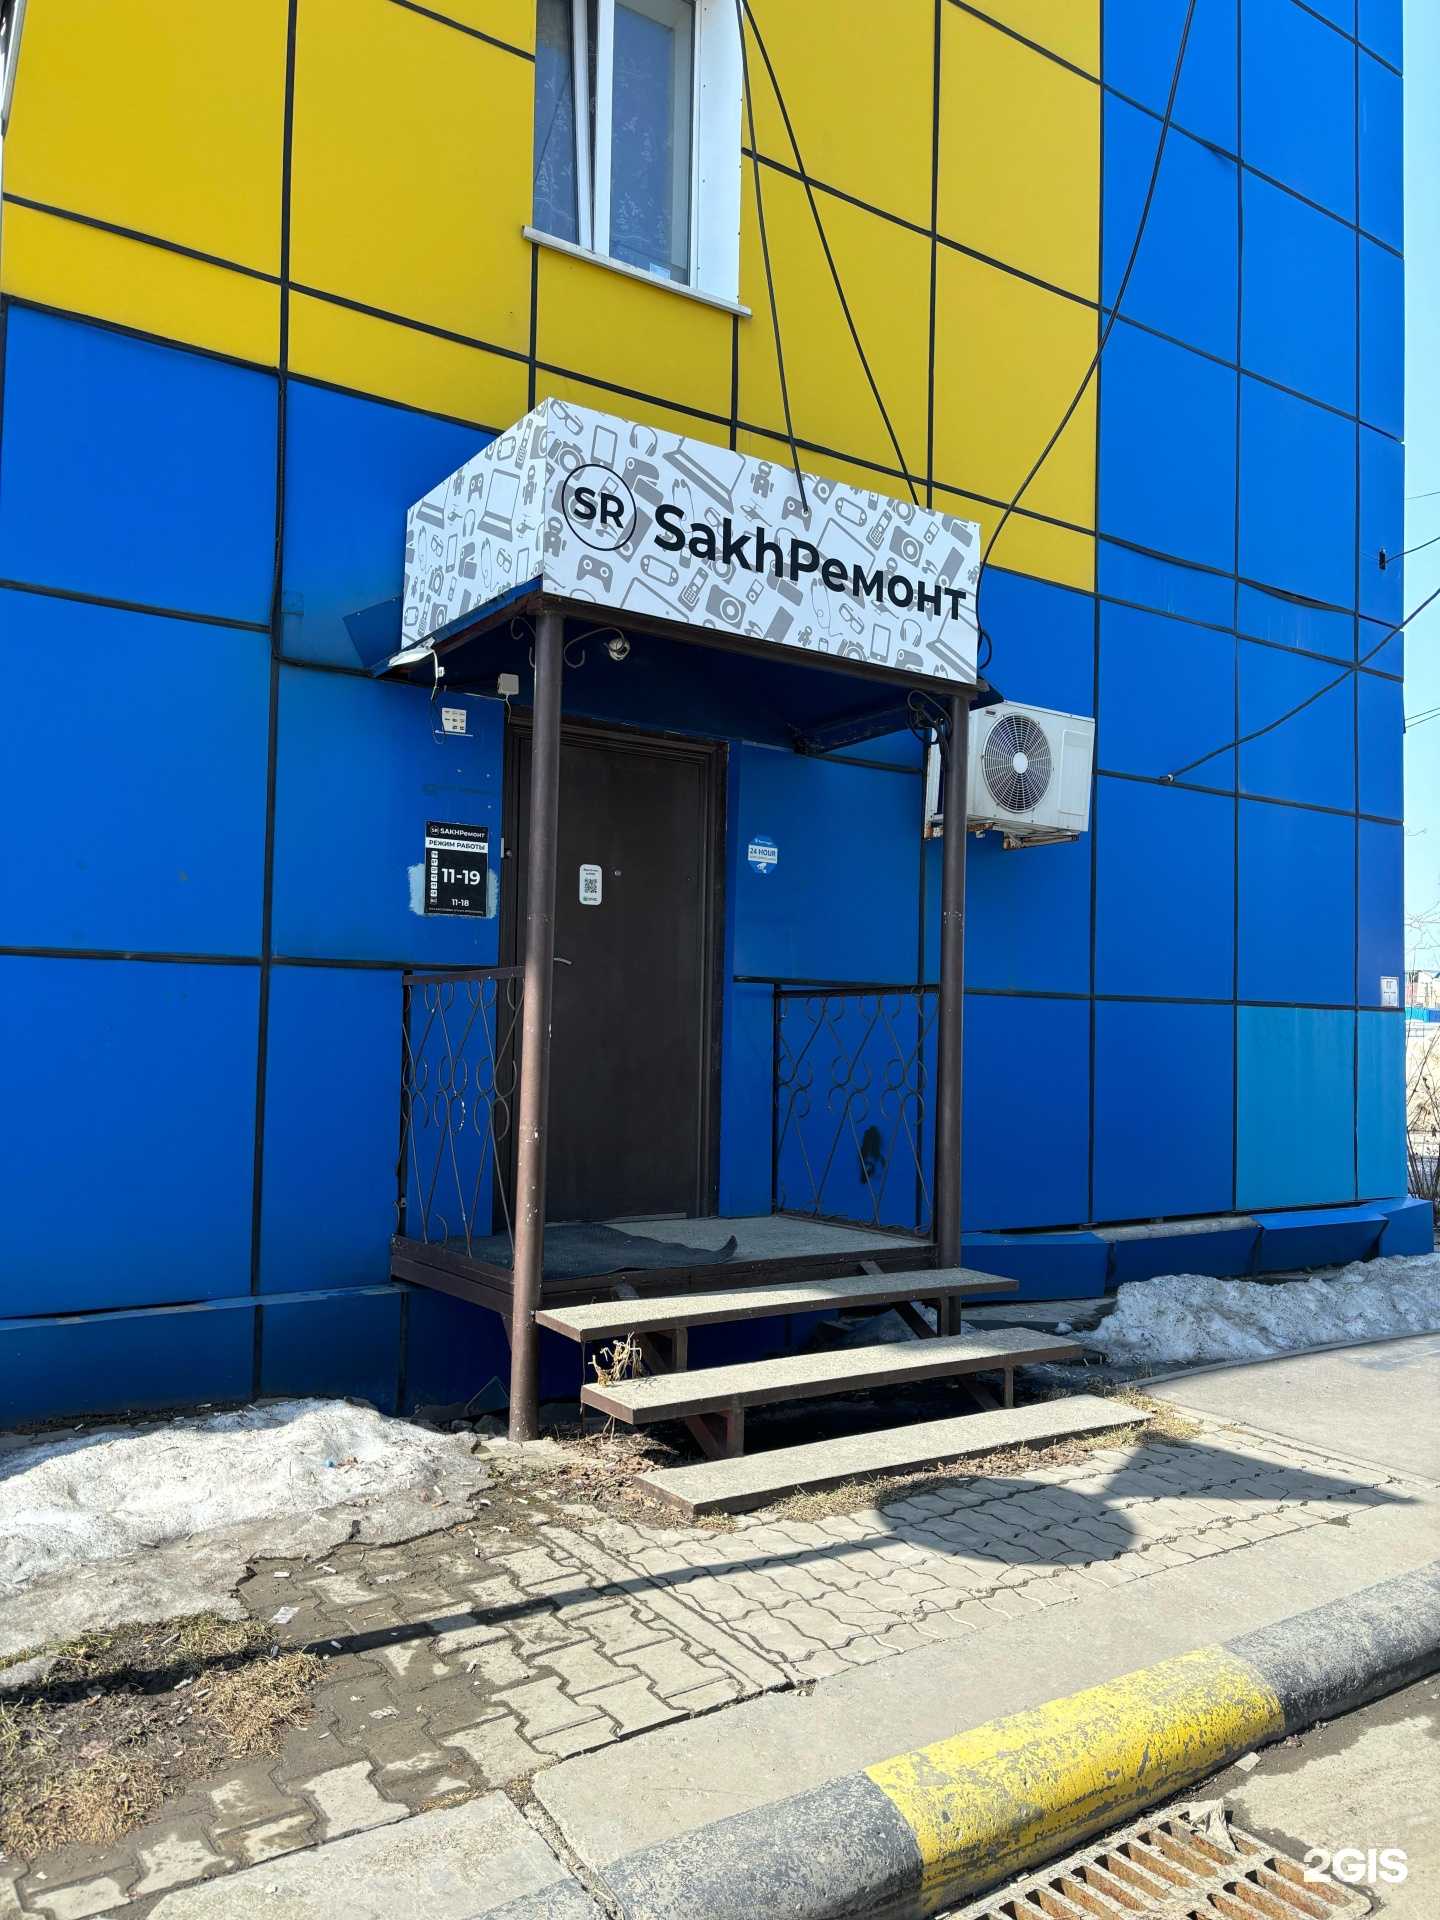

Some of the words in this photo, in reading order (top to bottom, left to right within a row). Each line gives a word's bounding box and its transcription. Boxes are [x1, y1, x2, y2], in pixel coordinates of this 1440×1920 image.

[573, 486, 625, 528] SR
[653, 503, 967, 621] SakhРемонт
[429, 839, 455, 847] РЕЖИМ
[456, 842, 485, 850] РАБОТЫ
[758, 848, 776, 856] HOUR
[441, 868, 481, 885] 11-19
[451, 898, 470, 906] 11-18
